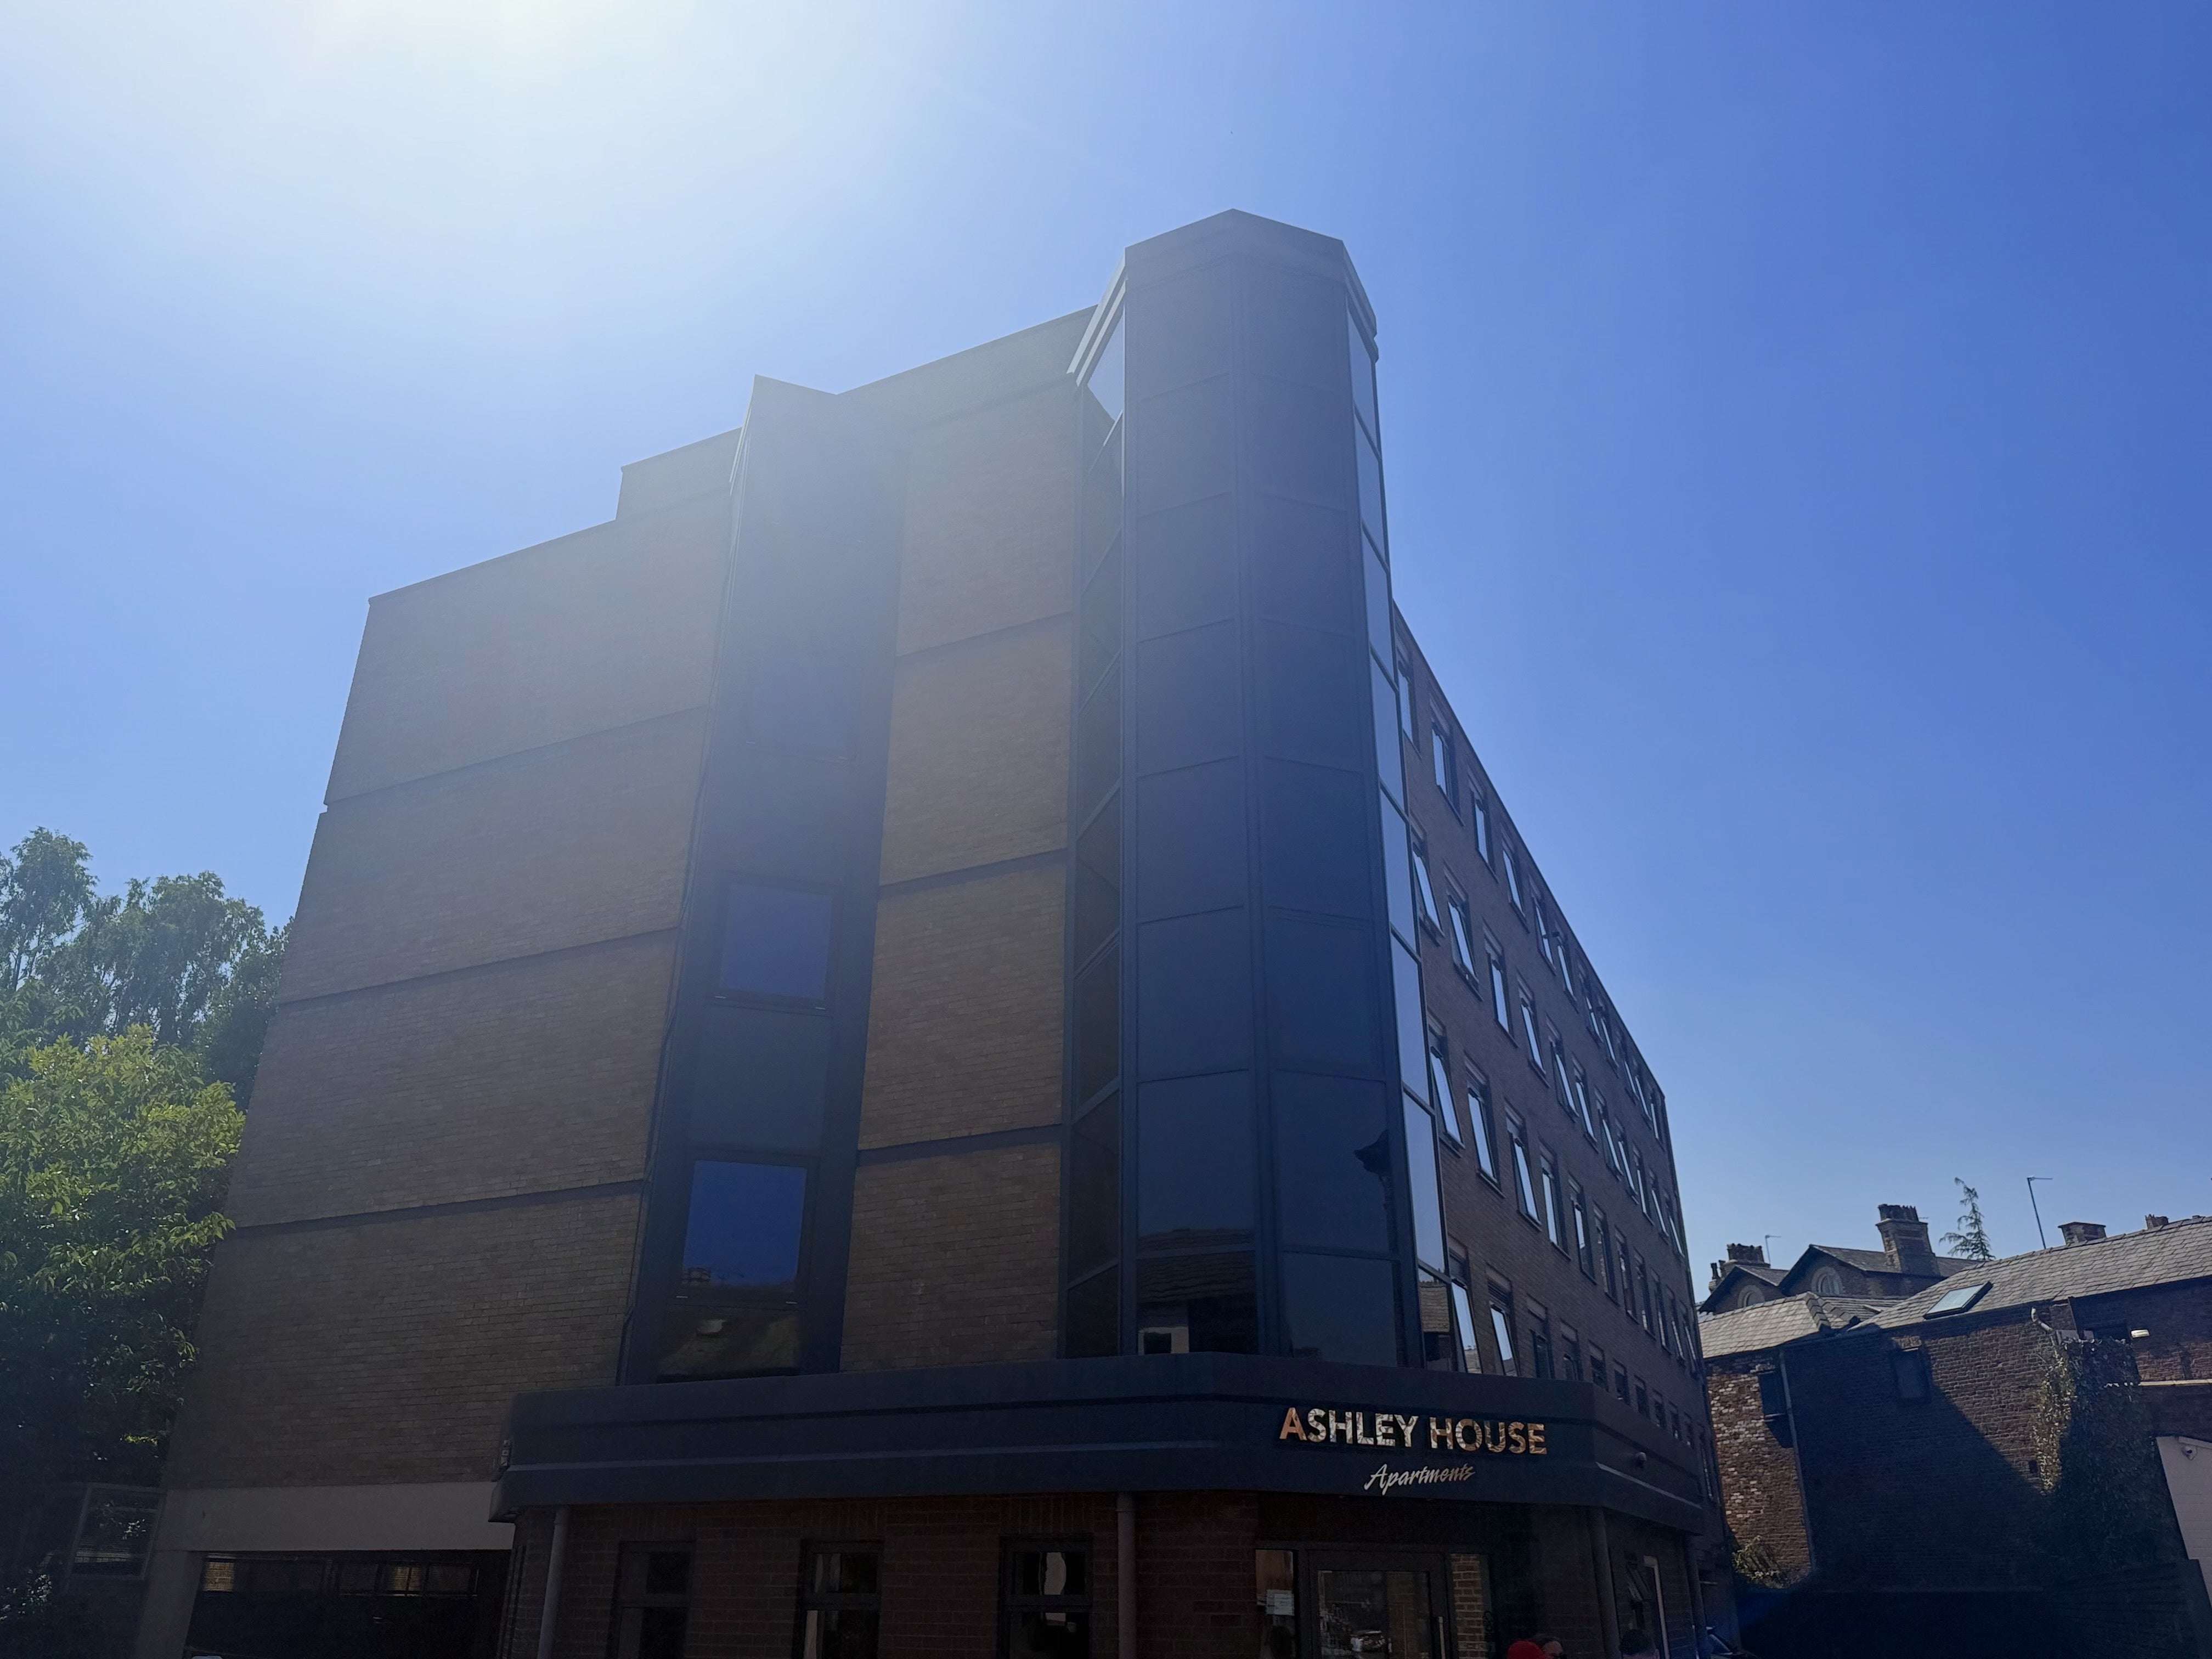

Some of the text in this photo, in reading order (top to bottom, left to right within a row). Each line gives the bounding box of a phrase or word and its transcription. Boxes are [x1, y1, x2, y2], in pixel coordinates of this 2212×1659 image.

[1279, 1407, 1548, 1455] ASHLEY HOUSE
[1363, 1463, 1476, 1495] Apartments
